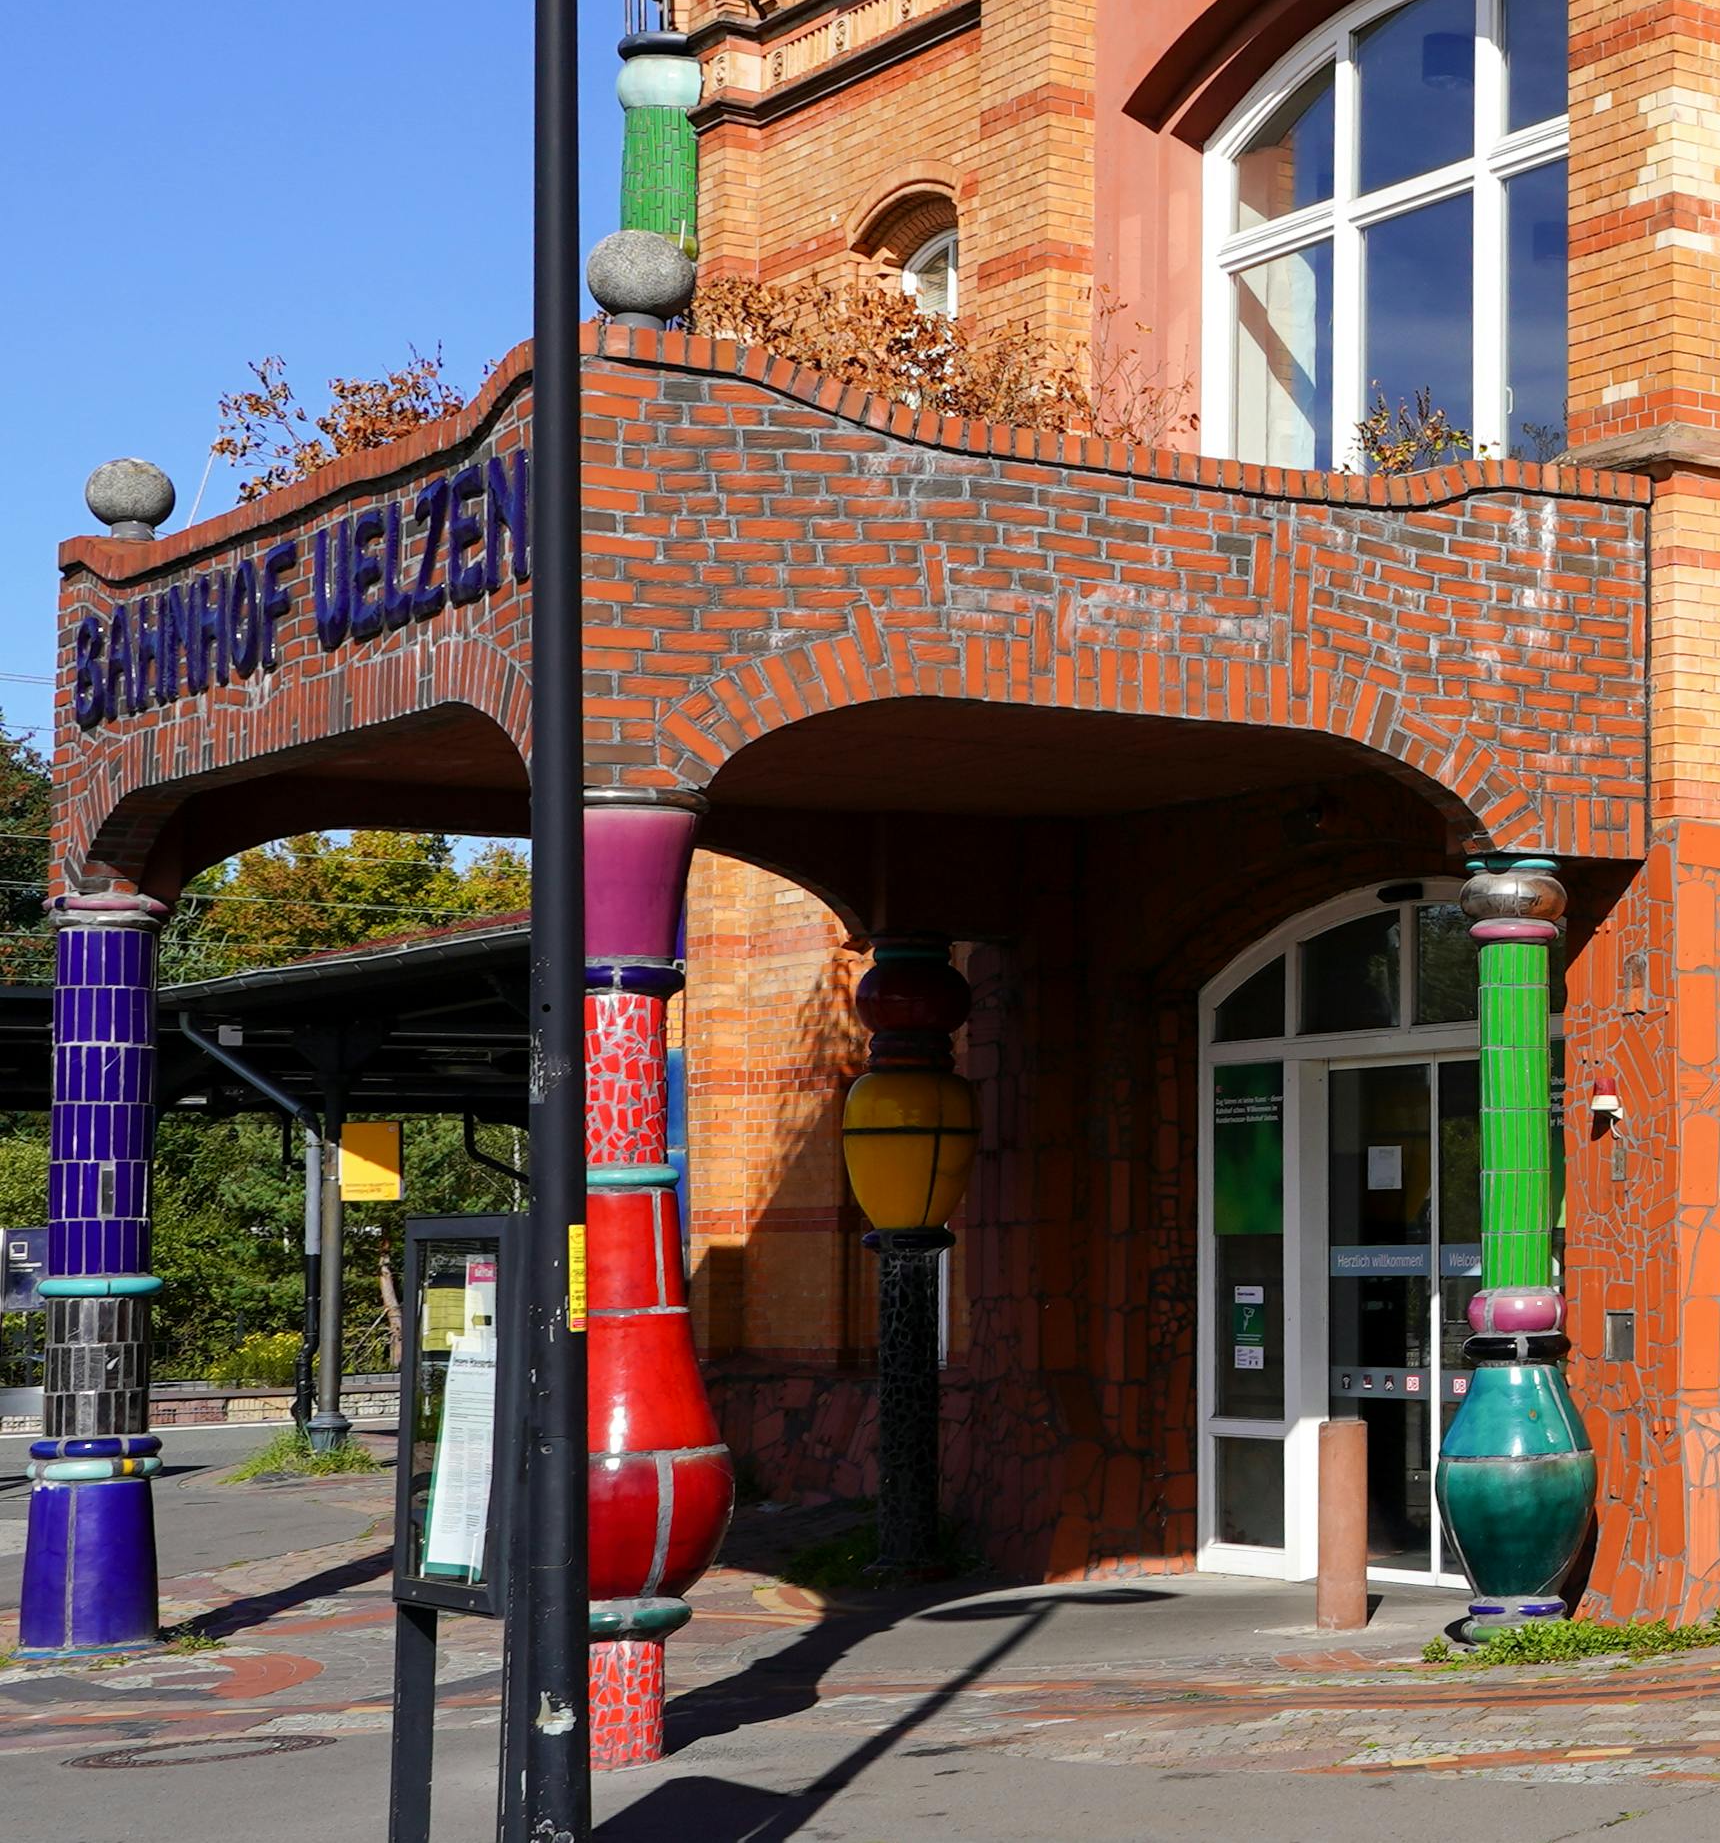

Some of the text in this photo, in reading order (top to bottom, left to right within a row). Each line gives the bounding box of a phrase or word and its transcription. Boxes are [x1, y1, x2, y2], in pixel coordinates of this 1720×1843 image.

[75, 448, 530, 731] BAHNHOF UELZEN
[1337, 1253, 1424, 1268] Herzlich willkommen!
